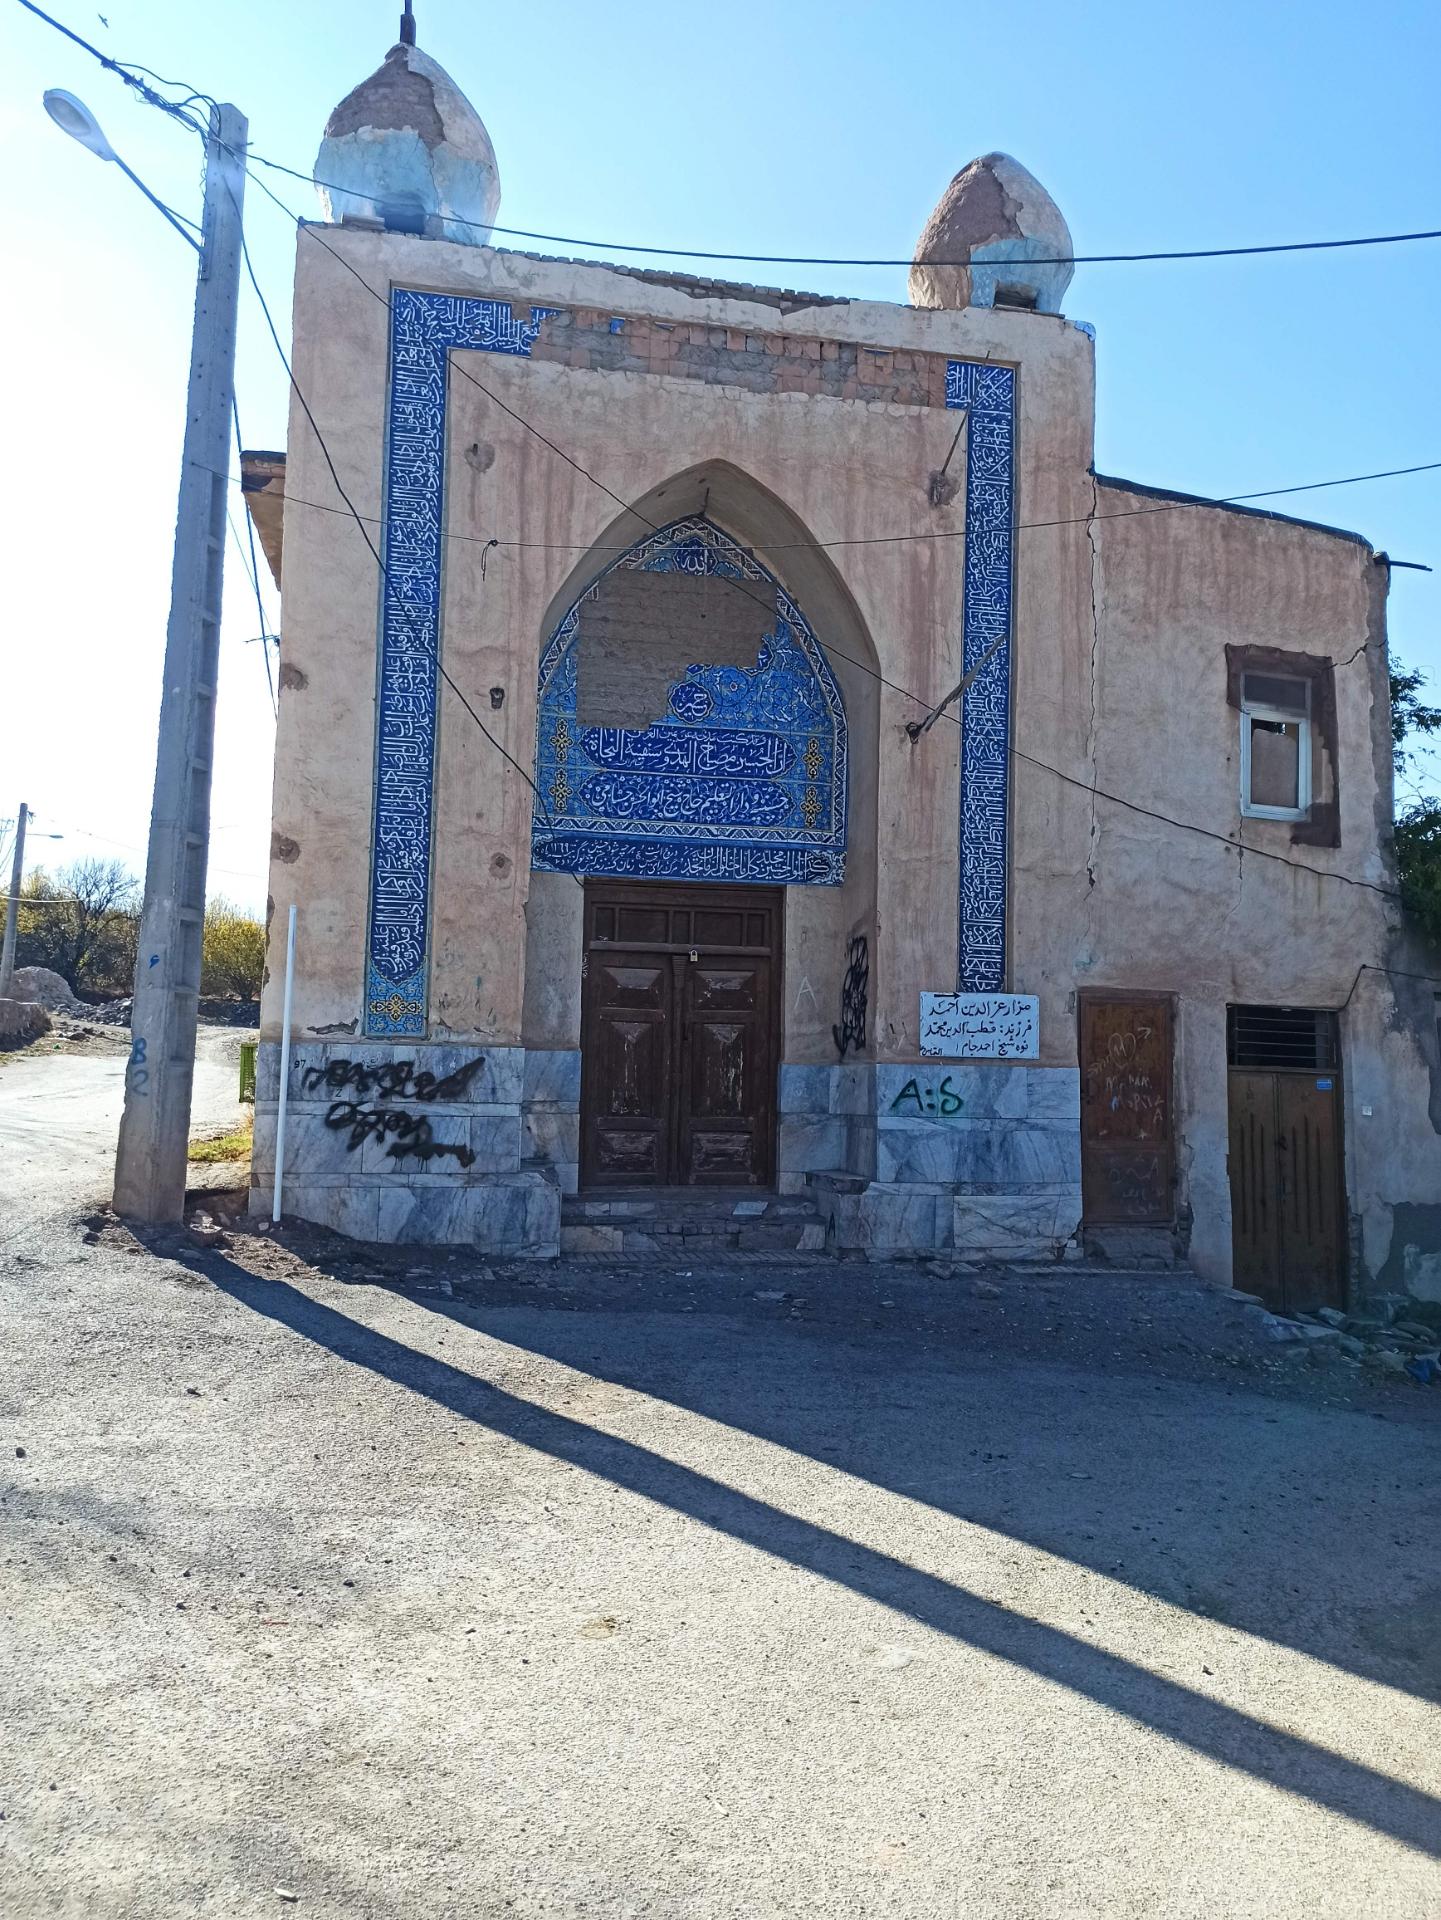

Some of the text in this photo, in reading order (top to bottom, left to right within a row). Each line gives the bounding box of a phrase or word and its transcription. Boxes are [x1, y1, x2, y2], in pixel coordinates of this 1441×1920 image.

[929, 1000, 1032, 1018] مزار عز الدین احمد
[924, 1021, 948, 1037] محمد
[941, 1021, 966, 1037] الدین
[966, 1020, 997, 1038] قطب
[962, 1037, 1029, 1056] نوه شیخ احمد جام
